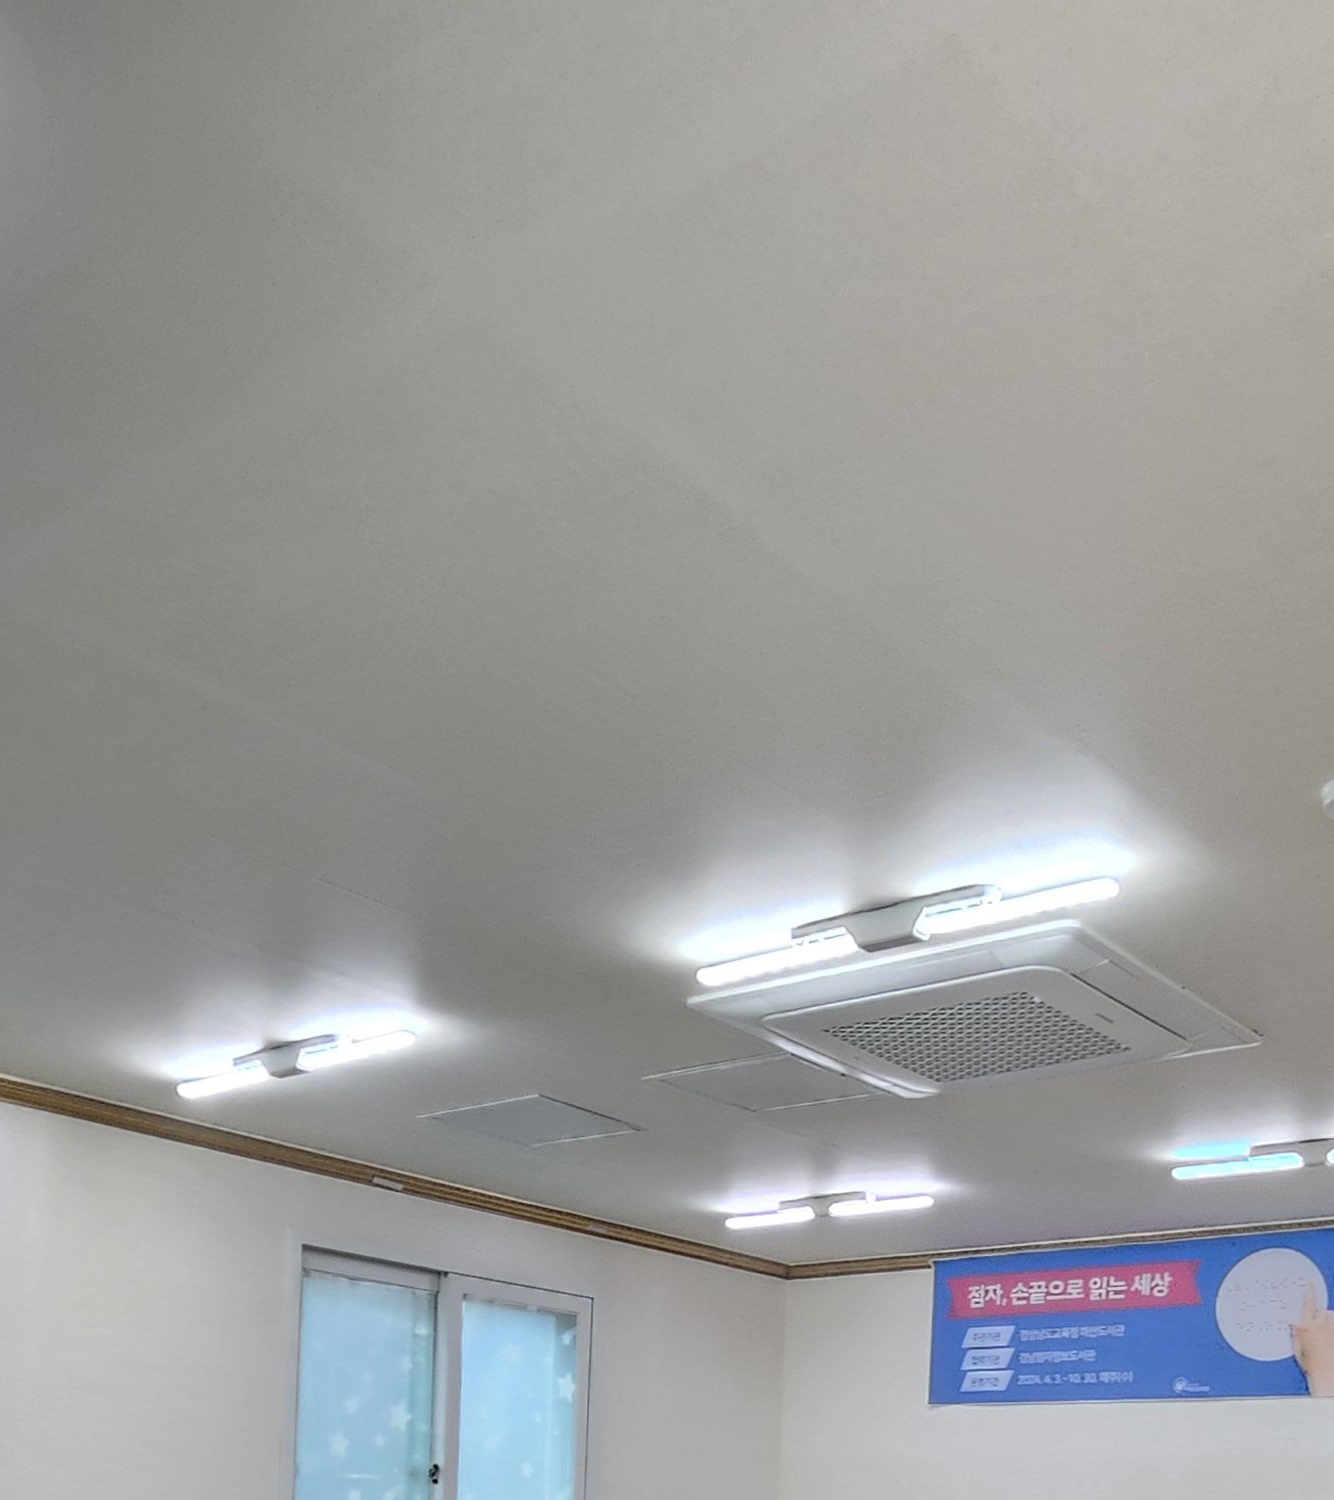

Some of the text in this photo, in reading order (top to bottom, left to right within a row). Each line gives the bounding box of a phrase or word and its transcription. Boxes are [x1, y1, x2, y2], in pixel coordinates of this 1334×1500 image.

[968, 1271, 1172, 1308] 점자, 손끝으로 읽는 세상
